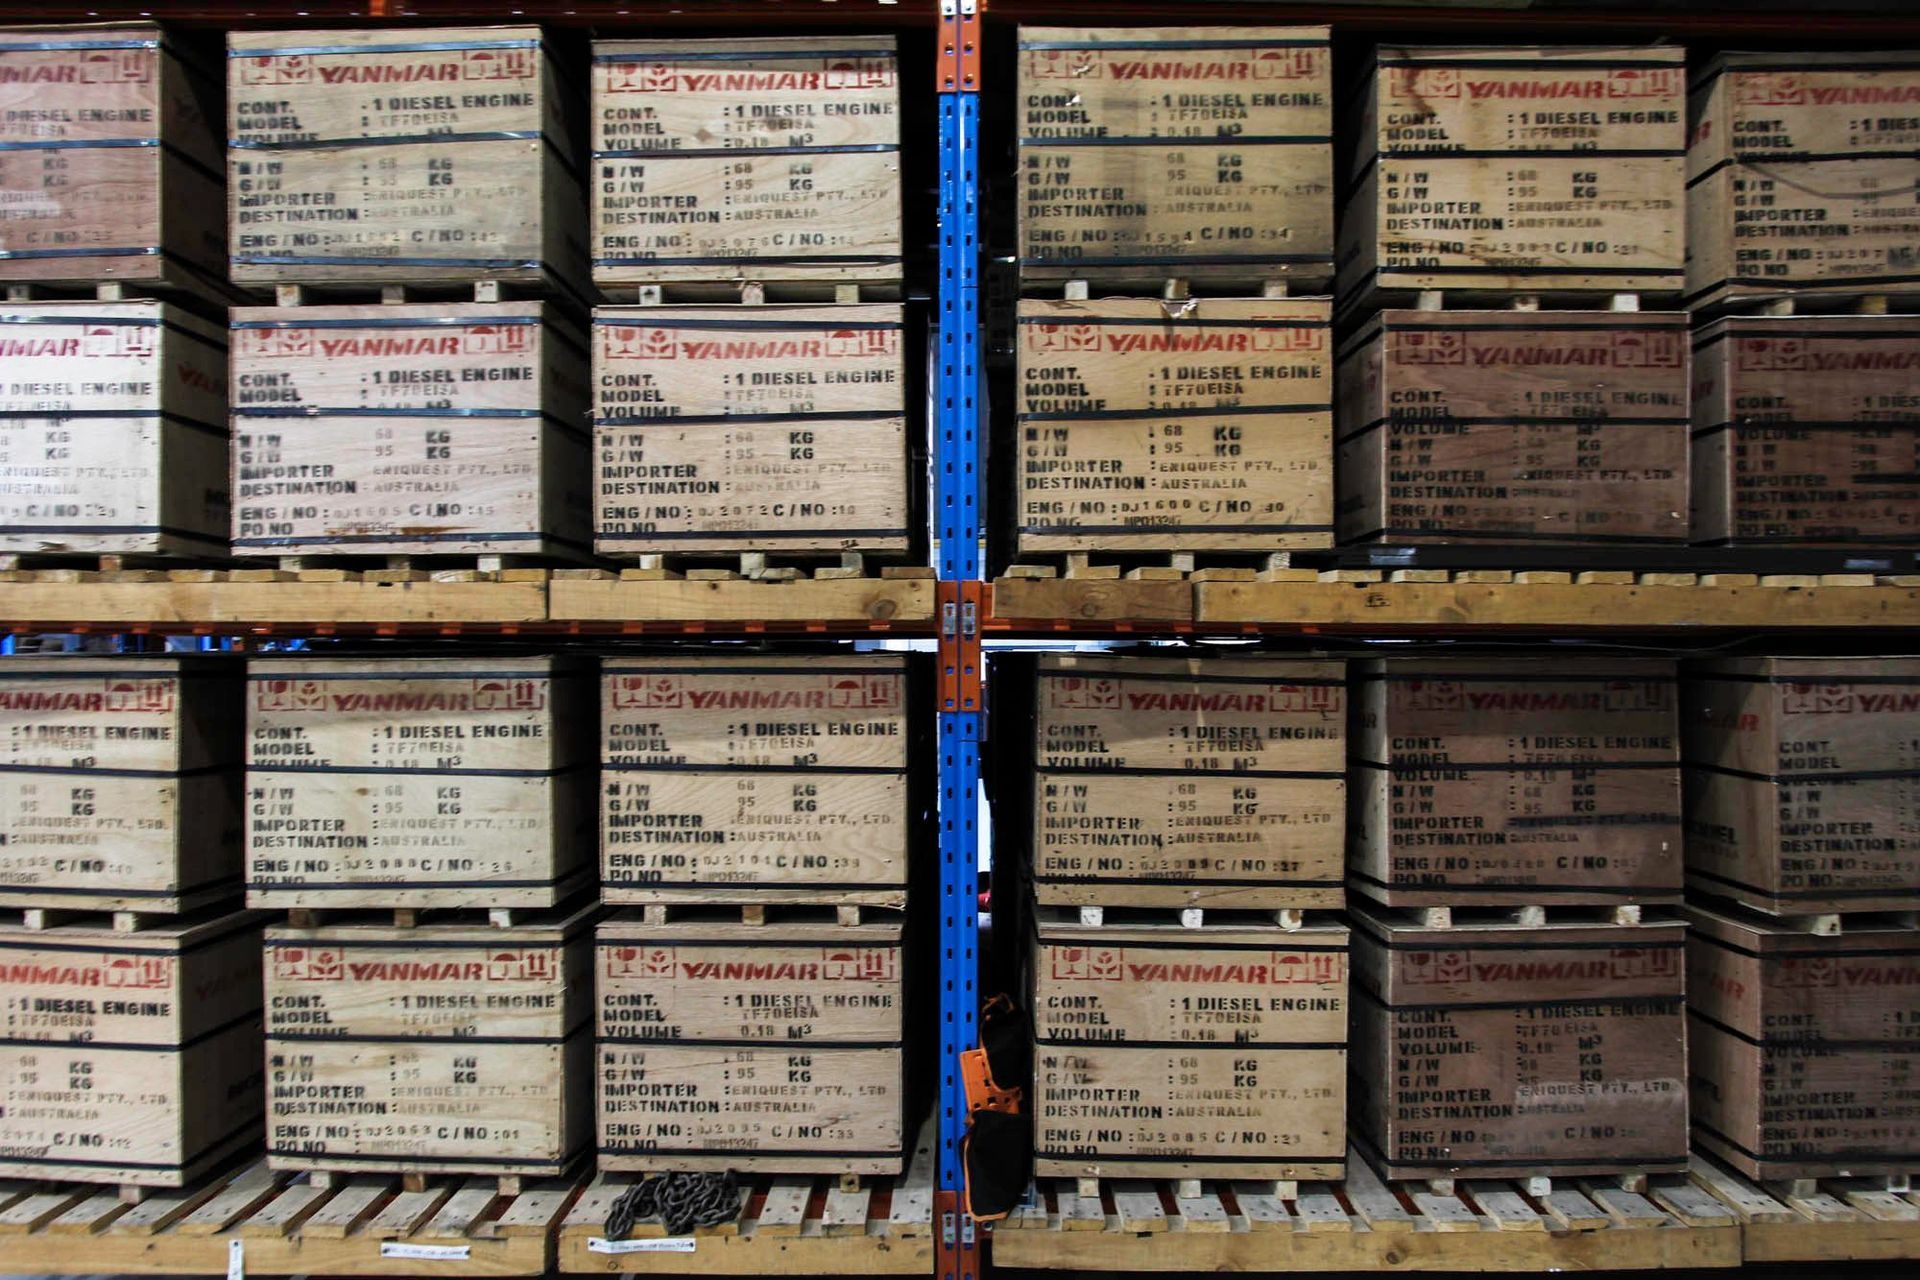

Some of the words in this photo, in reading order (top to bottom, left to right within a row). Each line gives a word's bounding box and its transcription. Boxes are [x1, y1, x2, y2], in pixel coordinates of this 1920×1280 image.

[319, 64, 459, 83] YANMAR
[1108, 62, 1248, 79] YANMAR
[682, 72, 820, 92] YANMAR
[1466, 81, 1603, 98] YANMAR
[238, 101, 294, 114] CONT.
[389, 97, 456, 109] DIESEL
[462, 94, 533, 107] ENGINE
[1178, 94, 1245, 107] DIESEL
[1252, 93, 1323, 106] ENGINE
[78, 109, 152, 121] ENGINE
[604, 108, 657, 119] CONT.
[751, 104, 816, 117] DIESEL
[824, 103, 893, 116] ENGINE
[1028, 110, 1091, 123] MODEL
[1535, 112, 1600, 124] DIESEL
[1607, 111, 1678, 123] ENGINE
[238, 117, 302, 130] MODEL
[603, 123, 665, 135] MODEL
[1387, 128, 1449, 140] MODEL
[604, 138, 681, 150] VOLUME
[1733, 136, 1793, 147] MODEL
[1028, 188, 1124, 200] IMPORTER
[603, 196, 698, 208] IMPORTER
[1387, 202, 1482, 214] IMPORTER
[240, 209, 358, 223] DESTINATION
[1028, 204, 1147, 218] DESTINATION
[603, 212, 720, 224] DESTINATION
[1387, 219, 1503, 230] DESTINATION
[1735, 225, 1849, 237] DESTINATION
[320, 337, 458, 357] YANMAR
[1107, 334, 1247, 352] YANMAR
[681, 341, 820, 359] YANMAR
[1471, 348, 1608, 367] YANMAR
[240, 373, 294, 387] CONT.
[389, 370, 455, 383] DIESEL
[462, 368, 533, 381] ENGINE
[602, 375, 656, 386] CONT.
[752, 372, 817, 384] DIESEL
[825, 370, 895, 383] ENGINE
[1026, 368, 1081, 379] CONT.
[1177, 367, 1244, 379] DIESEL
[1251, 366, 1321, 378] ENGINE
[11, 384, 73, 395] DIESEL
[81, 383, 151, 395] ENGINE
[1025, 384, 1089, 396] MODEL
[240, 390, 302, 402] MODEL
[602, 390, 665, 402] MODEL
[1540, 392, 1603, 405] DIESEL
[46, 432, 70, 443] KG
[790, 432, 814, 444] KG
[1164, 426, 1182, 436] 68
[1214, 426, 1242, 440] KG
[1165, 443, 1183, 454] 95
[241, 465, 333, 479] IMPORTER
[602, 465, 697, 478] IMPORTER
[1026, 460, 1122, 473] IMPORTER
[1390, 470, 1485, 482] IMPORTER
[240, 482, 356, 496] DESTINATION
[602, 482, 719, 494] DESTINATION
[1026, 477, 1145, 490] DESTINATION
[1390, 486, 1507, 498] DESTINATION
[332, 694, 470, 711] YANMAR
[686, 691, 824, 709] YANMAR
[1127, 694, 1267, 712] YANMAR
[38, 726, 97, 739] DIESEL
[105, 727, 170, 740] ENGINE
[255, 727, 306, 739] CONT.
[401, 726, 464, 738] DIESEL
[472, 725, 543, 737] ENGINE
[610, 724, 662, 735] CONT.
[756, 723, 820, 735] DIESEL
[828, 723, 898, 735] ENGINE
[1196, 726, 1261, 739] DIESEL
[1269, 727, 1338, 740] ENGINE
[254, 743, 314, 755] MODEL
[609, 739, 670, 751] MODEL
[1046, 740, 1109, 752] MODEL
[1392, 738, 1445, 749] CONT.
[1535, 737, 1598, 749] DIESEL
[1604, 736, 1672, 749] ENGINE
[1779, 757, 1841, 769] MODEL
[72, 789, 95, 800] KG
[254, 819, 345, 831] IMPORTER
[609, 815, 703, 827] IMPORTER
[1046, 817, 1140, 830] IMPORTER
[1394, 817, 1484, 829] IMPORTER
[254, 835, 368, 848] DESTINATION
[609, 831, 724, 843] DESTINATION
[1046, 834, 1162, 846] DESTINATION
[1394, 834, 1506, 846] DESTINATION
[1780, 839, 1895, 851] DESTINATION
[350, 963, 484, 981] YANMAR
[681, 963, 819, 980] YANMAR
[1128, 964, 1268, 984] YANMAR
[1475, 961, 1608, 981] YANMAR
[34, 999, 96, 1013] DIESEL
[103, 1001, 170, 1016] ENGINE
[272, 996, 325, 1008] CONT.
[417, 996, 479, 1008] DIESEL
[487, 995, 555, 1007] ENGINE
[605, 995, 658, 1006] CONT.
[752, 995, 814, 1007] DIESEL
[823, 995, 891, 1007] ENGINE
[1048, 997, 1102, 1009] CONT.
[1198, 998, 1263, 1011] DIESEL
[1270, 999, 1340, 1011] ENGINE
[273, 1012, 332, 1024] MODEL
[604, 1009, 666, 1022] MODEL
[1543, 1005, 1604, 1018] DIESEL
[1047, 1012, 1110, 1025] MODEL
[605, 1026, 681, 1038] VOLUME
[1048, 1028, 1126, 1040] VOLUME
[1399, 1026, 1458, 1038] MODEL
[70, 1063, 93, 1074] KG
[737, 1068, 755, 1079] 95
[789, 1071, 811, 1082] KG
[1180, 1074, 1198, 1085] 95
[274, 1086, 364, 1098] IMPORTER
[605, 1084, 697, 1096] IMPORTER
[1046, 1089, 1140, 1101] IMPORTER
[1399, 1089, 1491, 1103] IMPORTER
[275, 1103, 386, 1115] DESTINATION
[606, 1101, 719, 1113] DESTINATION
[1046, 1106, 1162, 1118] DESTINATION
[1400, 1105, 1512, 1119] DESTINATION
[1765, 1107, 1876, 1121] DESTINATION
